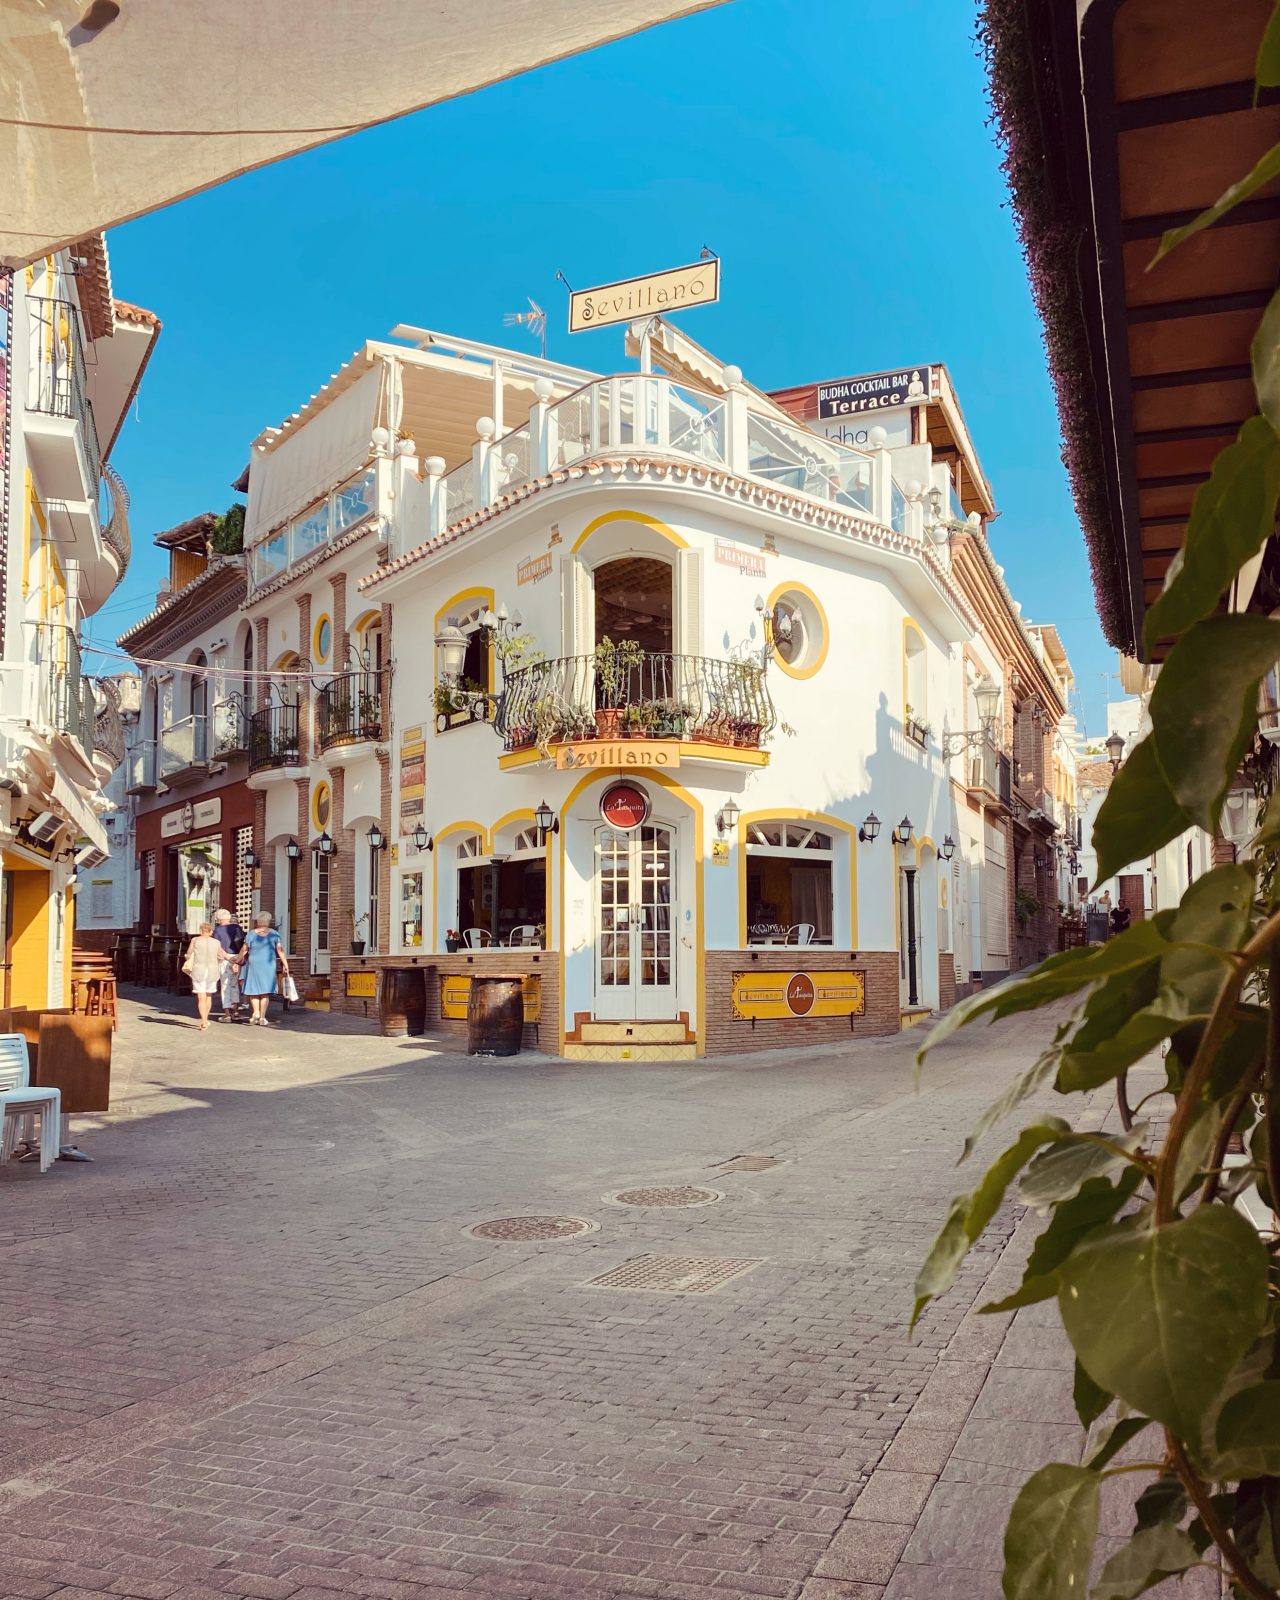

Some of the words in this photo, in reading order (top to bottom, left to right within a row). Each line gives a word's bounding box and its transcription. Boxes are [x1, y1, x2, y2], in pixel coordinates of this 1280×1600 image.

[581, 279, 705, 321] Sevillano
[820, 386, 850, 401] BUDHA
[850, 378, 891, 395] COCKTAIL
[892, 374, 909, 388] BAR
[829, 392, 901, 415] Terrace
[563, 746, 669, 767] Sevillano
[614, 798, 644, 813] Tasquita
